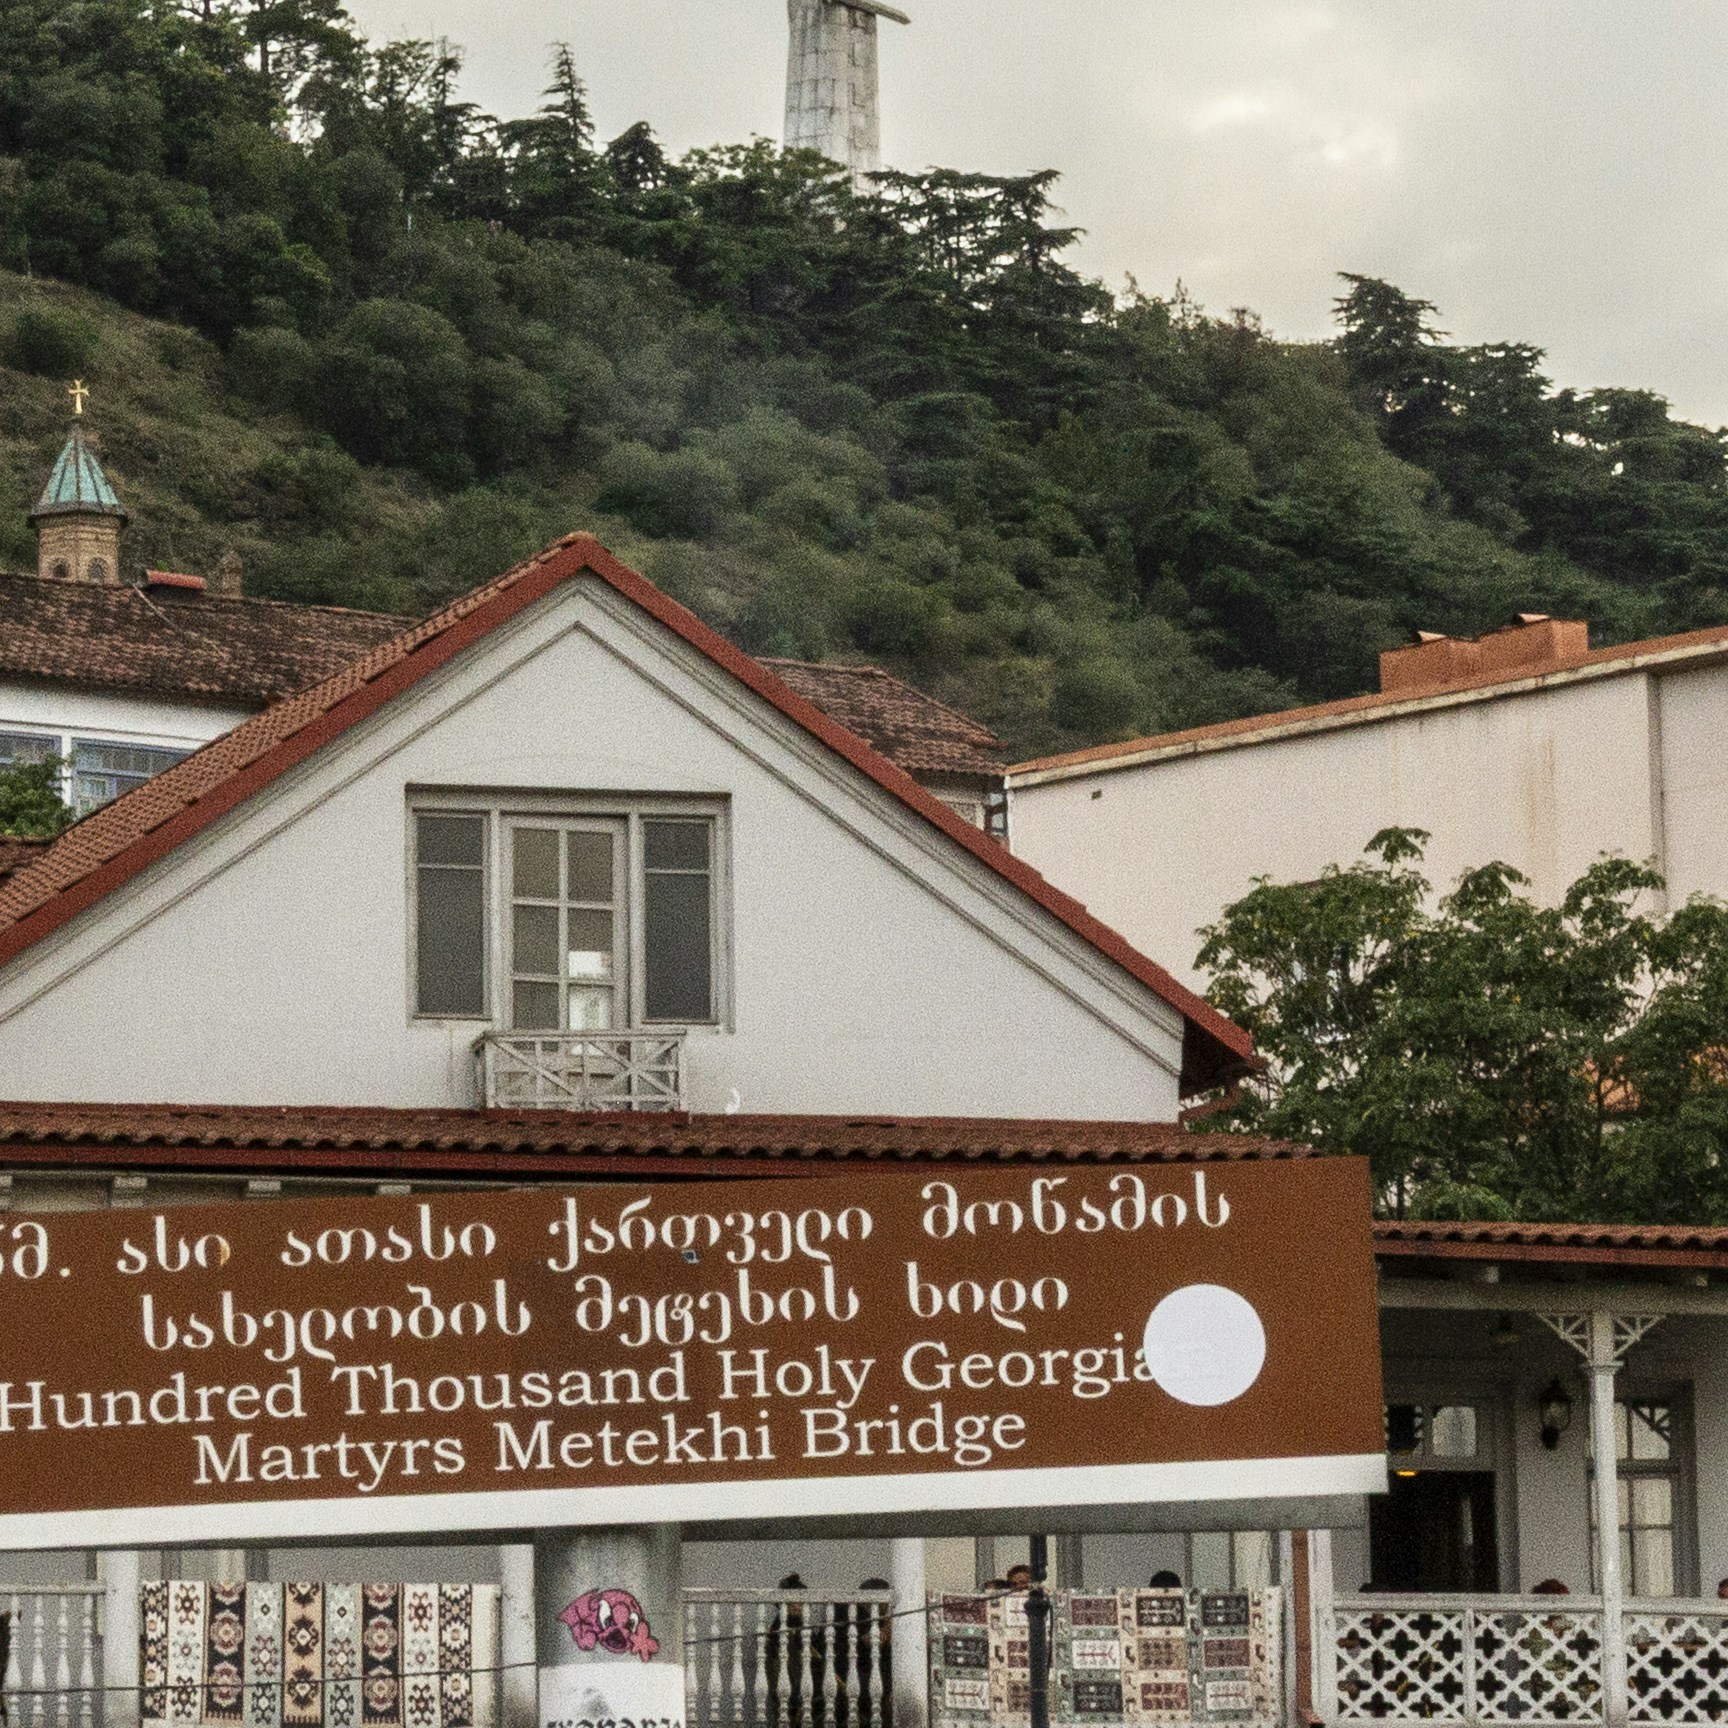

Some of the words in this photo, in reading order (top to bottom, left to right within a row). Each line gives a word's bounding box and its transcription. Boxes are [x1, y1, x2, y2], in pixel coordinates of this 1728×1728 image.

[116, 1215, 232, 1274] ასი
[280, 1203, 498, 1267] ათასი
[547, 1194, 874, 1271] ქართველი
[921, 1170, 1232, 1239] მოწამის
[142, 1278, 533, 1362] სახელობის
[574, 1264, 861, 1347] მეტეხის
[906, 1261, 1070, 1332] ხიდი
[330, 1350, 691, 1417] Thousand
[716, 1344, 877, 1408] Holy
[192, 1432, 467, 1494] Martyrs
[493, 1409, 777, 1473] Metekhi
[800, 1401, 1028, 1467] Bridge
